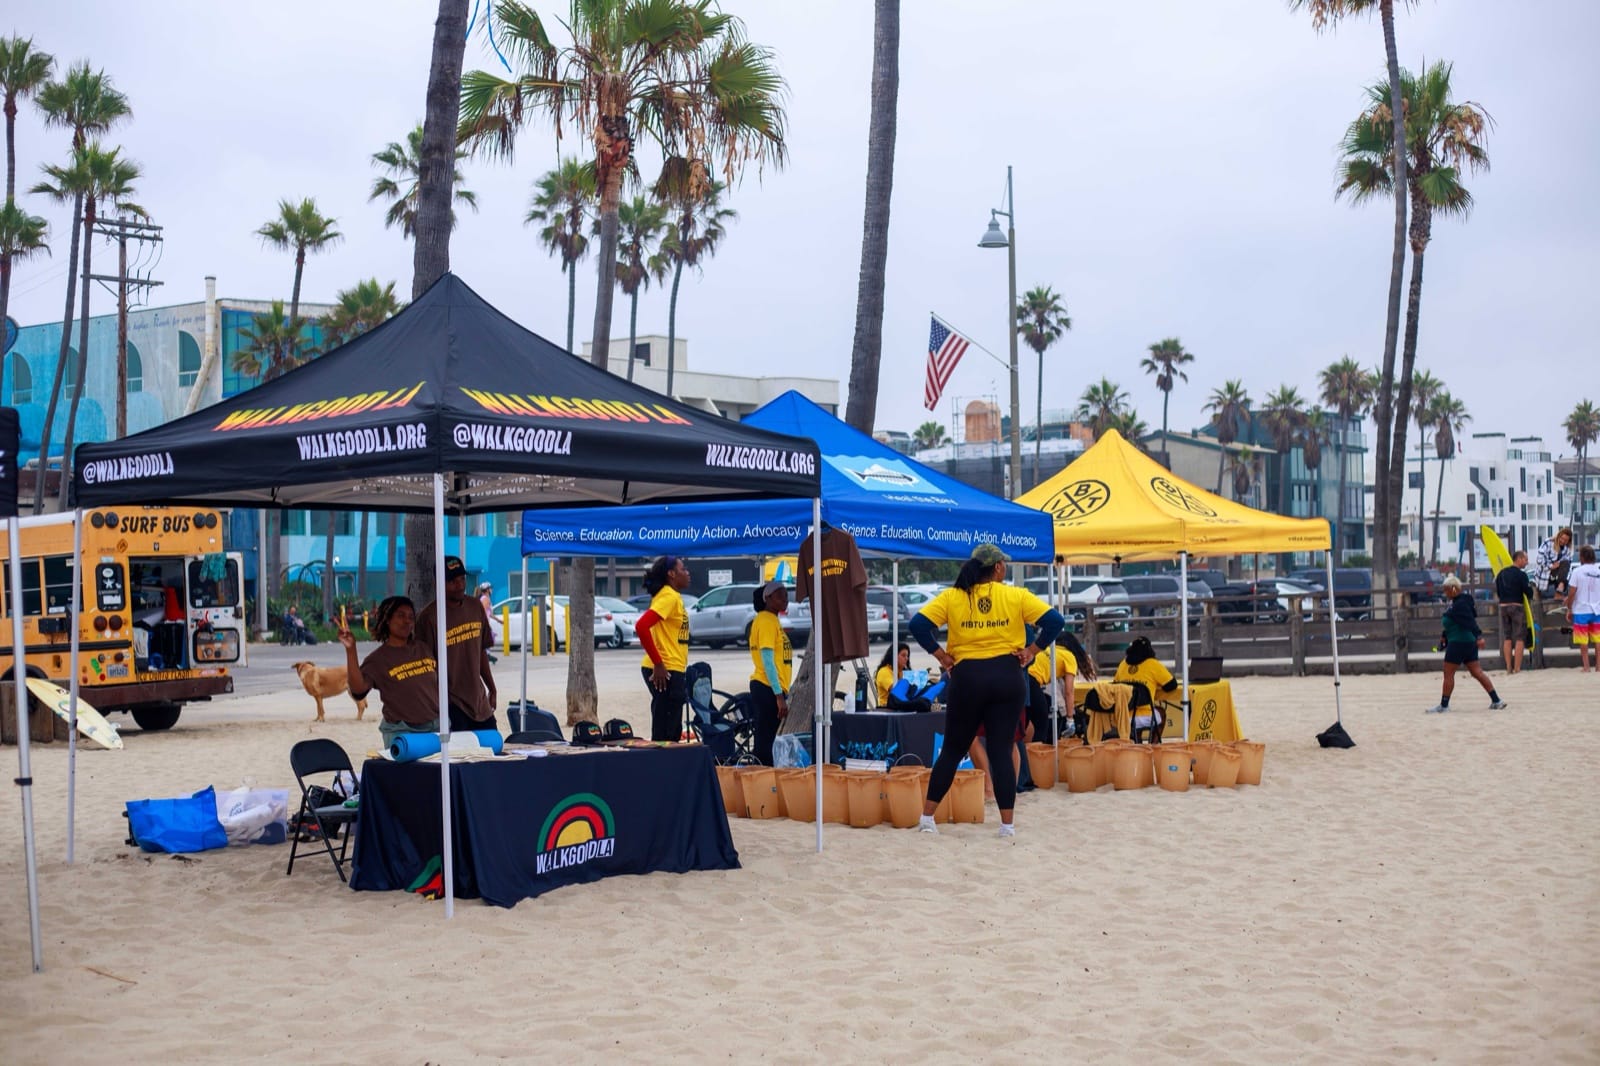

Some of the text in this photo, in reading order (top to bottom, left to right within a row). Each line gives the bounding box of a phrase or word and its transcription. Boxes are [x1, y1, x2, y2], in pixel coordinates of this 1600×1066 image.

[296, 422, 427, 461] WALKGOODLA.ORG
[453, 423, 573, 455] @WALKGOODLA
[83, 452, 174, 484] @WALKGOODLA
[705, 443, 815, 476] WALKGOODLA.ORG
[120, 515, 191, 534] SURF BUS
[534, 523, 801, 543] Science. Education. Community Action. Advocacy.
[841, 522, 878, 538] Science.
[881, 524, 925, 540] Education.
[927, 527, 972, 545] Community
[1000, 532, 1037, 550] Advocacy.
[961, 618, 1010, 630] #IBTU Relief
